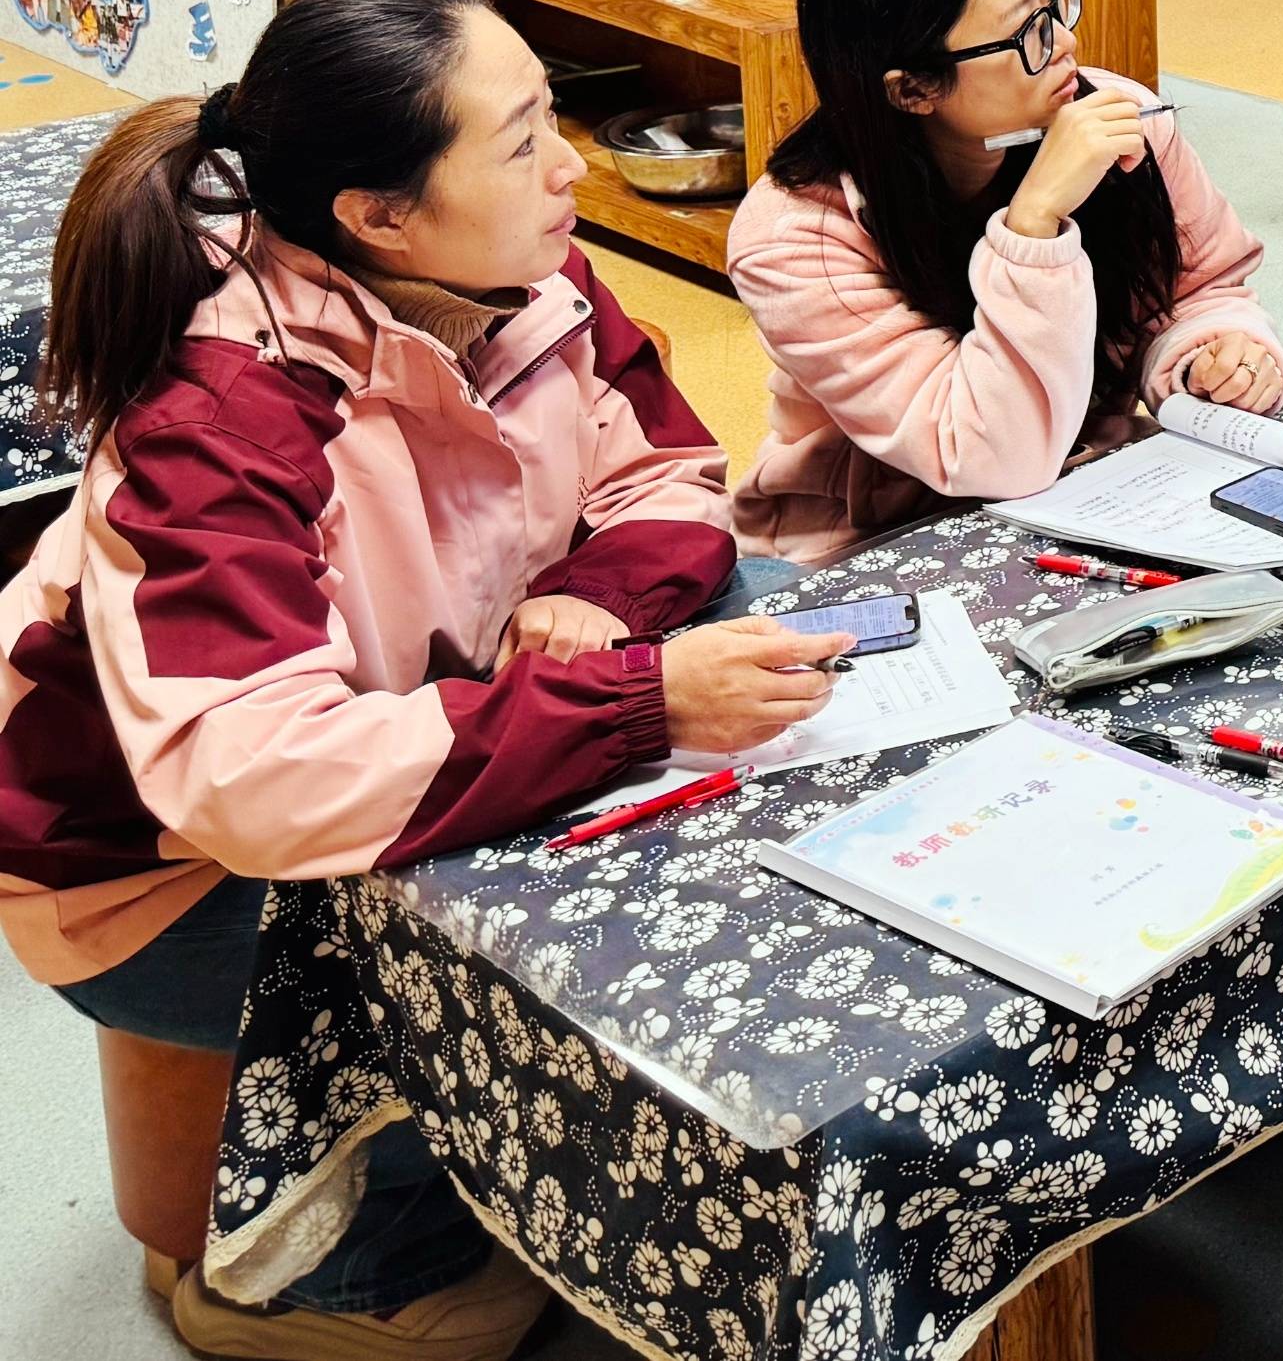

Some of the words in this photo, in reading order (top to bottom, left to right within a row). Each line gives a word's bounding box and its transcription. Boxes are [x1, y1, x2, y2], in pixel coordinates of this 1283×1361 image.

[892, 779, 1057, 868] 教师教研记录
